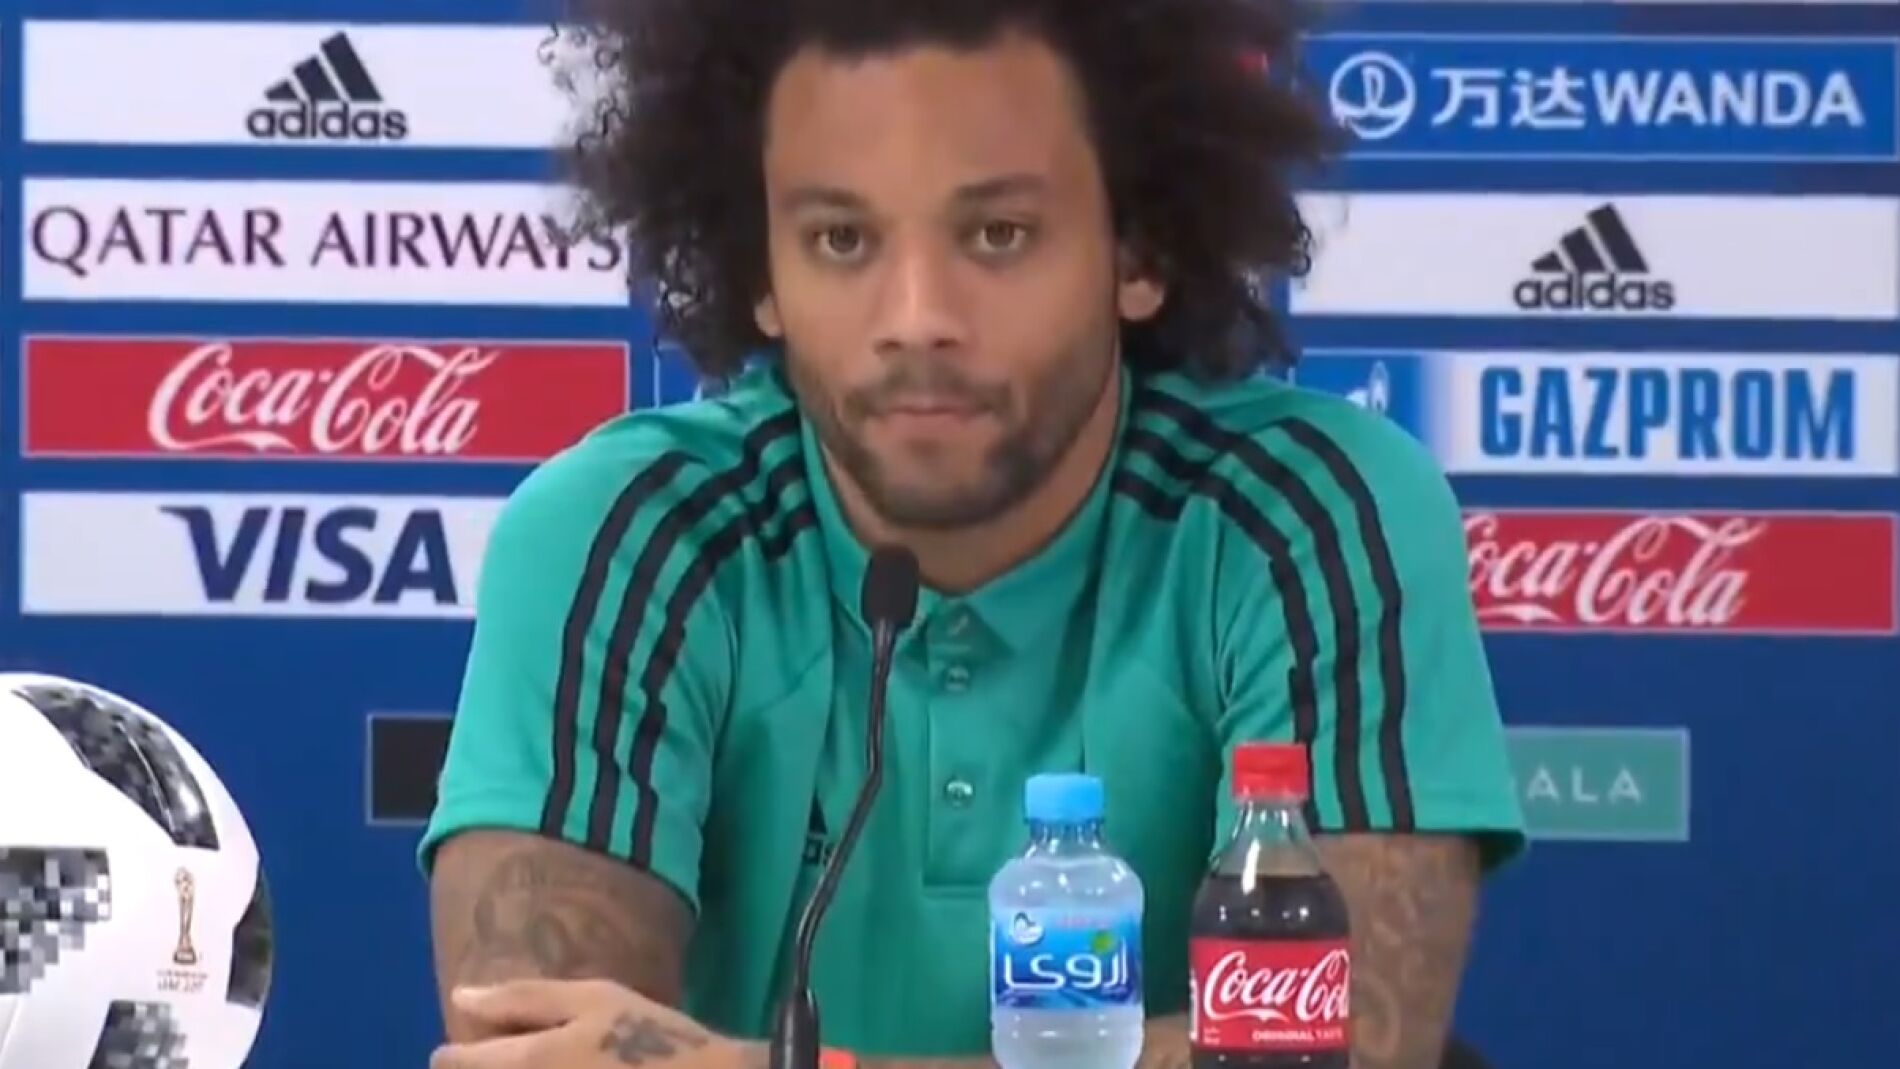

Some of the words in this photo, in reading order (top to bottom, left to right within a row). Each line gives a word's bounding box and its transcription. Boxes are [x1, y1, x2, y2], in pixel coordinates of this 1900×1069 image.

[247, 101, 409, 140] adidas
[1431, 67, 1587, 130] 万达
[1592, 71, 1865, 127] WANDA
[31, 205, 286, 278] QATAR
[310, 211, 622, 271] AIRWAYS
[1513, 274, 1676, 310] adidas
[147, 343, 501, 455] Coca-Cola
[1479, 366, 1857, 461] GAZPROM
[159, 506, 459, 606] VISA
